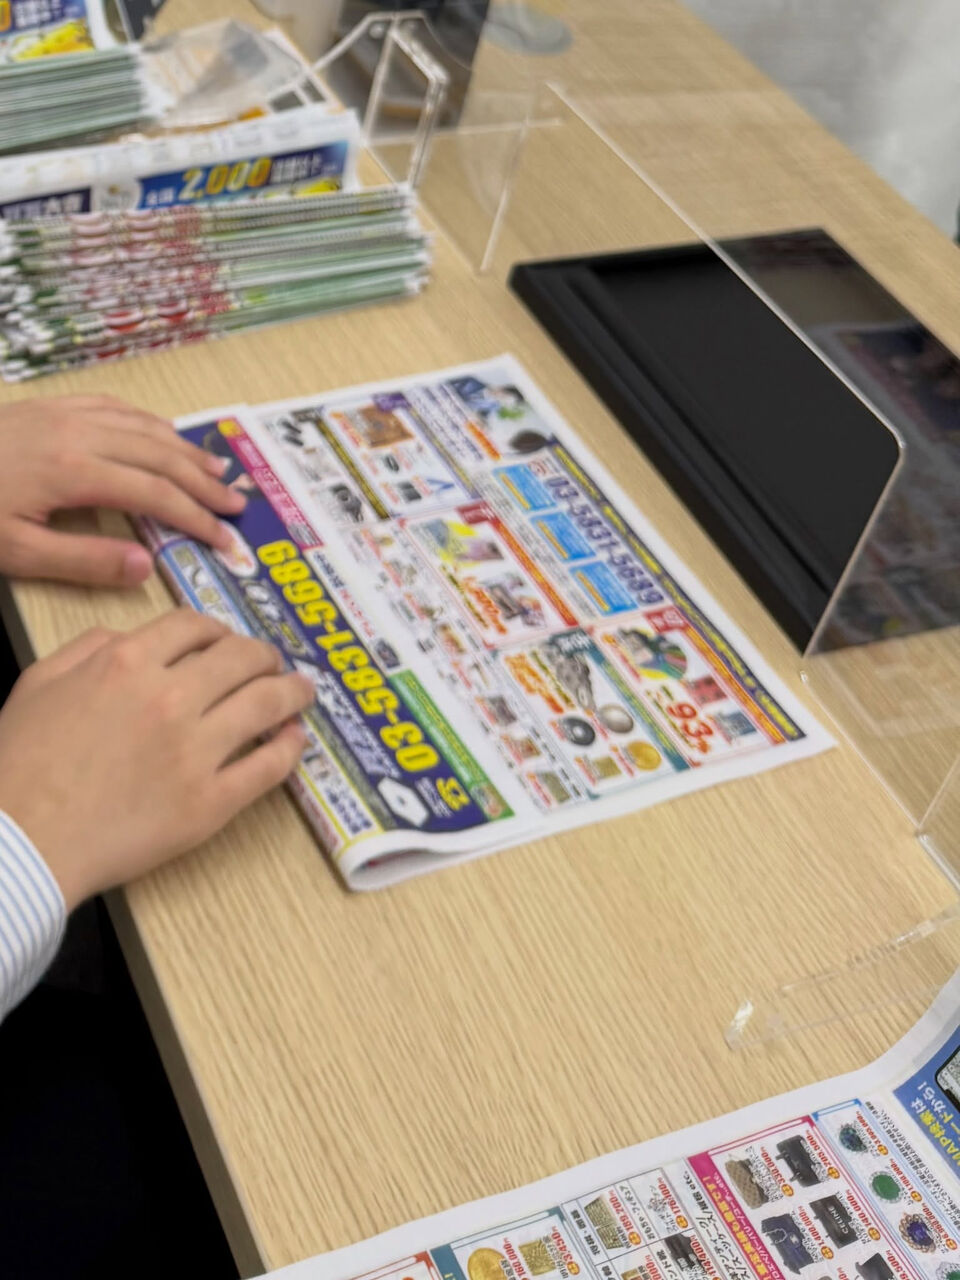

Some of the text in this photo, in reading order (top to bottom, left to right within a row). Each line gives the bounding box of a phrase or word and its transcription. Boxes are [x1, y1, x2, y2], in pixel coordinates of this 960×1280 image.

[174, 154, 275, 201] 2,000
[254, 542, 441, 774] 03-5831-5689
[827, 1204, 849, 1234] CELINE
